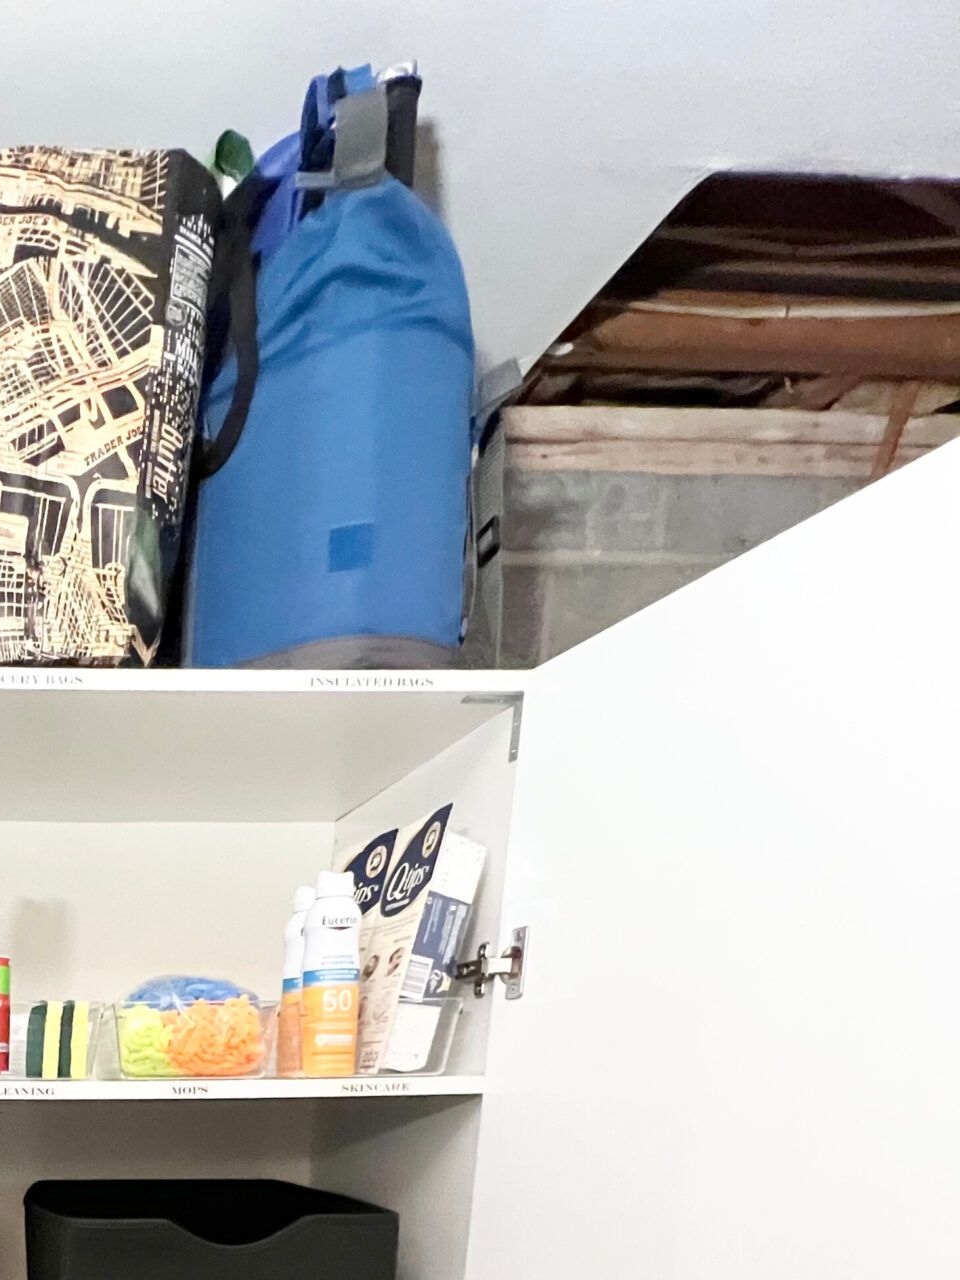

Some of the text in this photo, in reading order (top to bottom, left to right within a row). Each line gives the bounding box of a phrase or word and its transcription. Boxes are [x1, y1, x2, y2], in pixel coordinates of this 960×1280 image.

[83, 435, 123, 466] TRADER
[152, 422, 184, 503] Butter
[46, 675, 83, 685] BAGS
[310, 676, 434, 687] INSULATED BAGS
[322, 915, 357, 926] Eucerin
[172, 1085, 208, 1095] MOPS
[341, 1082, 410, 1092] SKINCARE
